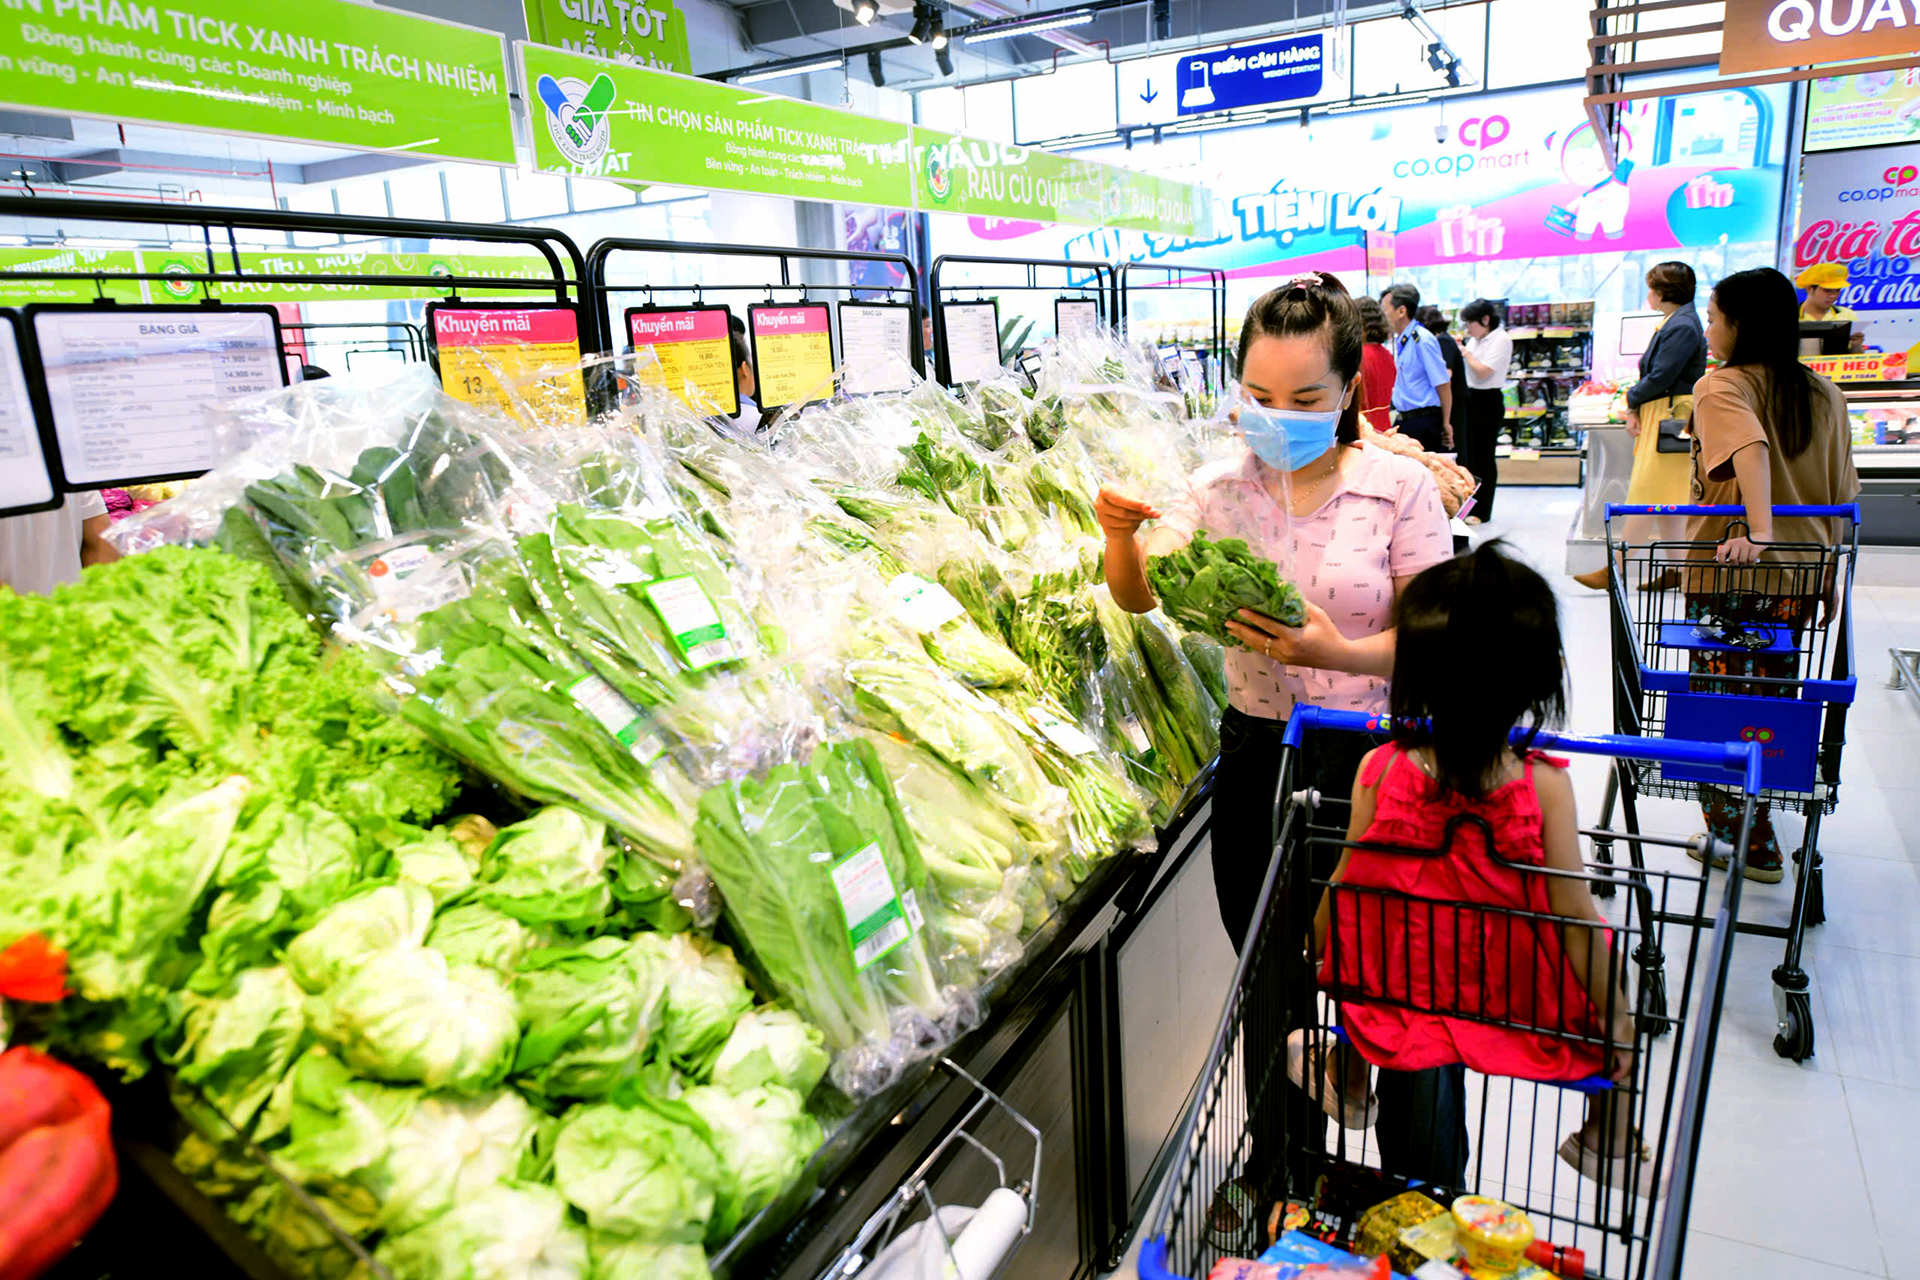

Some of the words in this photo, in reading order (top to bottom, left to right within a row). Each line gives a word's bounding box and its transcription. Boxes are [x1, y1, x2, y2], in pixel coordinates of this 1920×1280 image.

[165, 9, 243, 49] TICK
[246, 24, 329, 65] XANH
[333, 42, 421, 82] TRÁCH
[425, 60, 498, 96] NHIỆM
[236, 60, 293, 85] Doanh
[96, 66, 125, 86] An
[317, 98, 355, 119] Minh
[775, 126, 804, 147] TICK
[805, 131, 838, 153] XANH
[967, 165, 1005, 201] RAU
[1838, 186, 1920, 202] co.opma
[1848, 247, 1911, 279] cho
[436, 314, 500, 336] Khuyến
[502, 315, 531, 331] mãi
[632, 316, 674, 336] Khuyến
[675, 317, 694, 331] mãi
[756, 311, 789, 328] Khuyến
[790, 312, 805, 324] mãi
[1843, 360, 1880, 371] HEO
